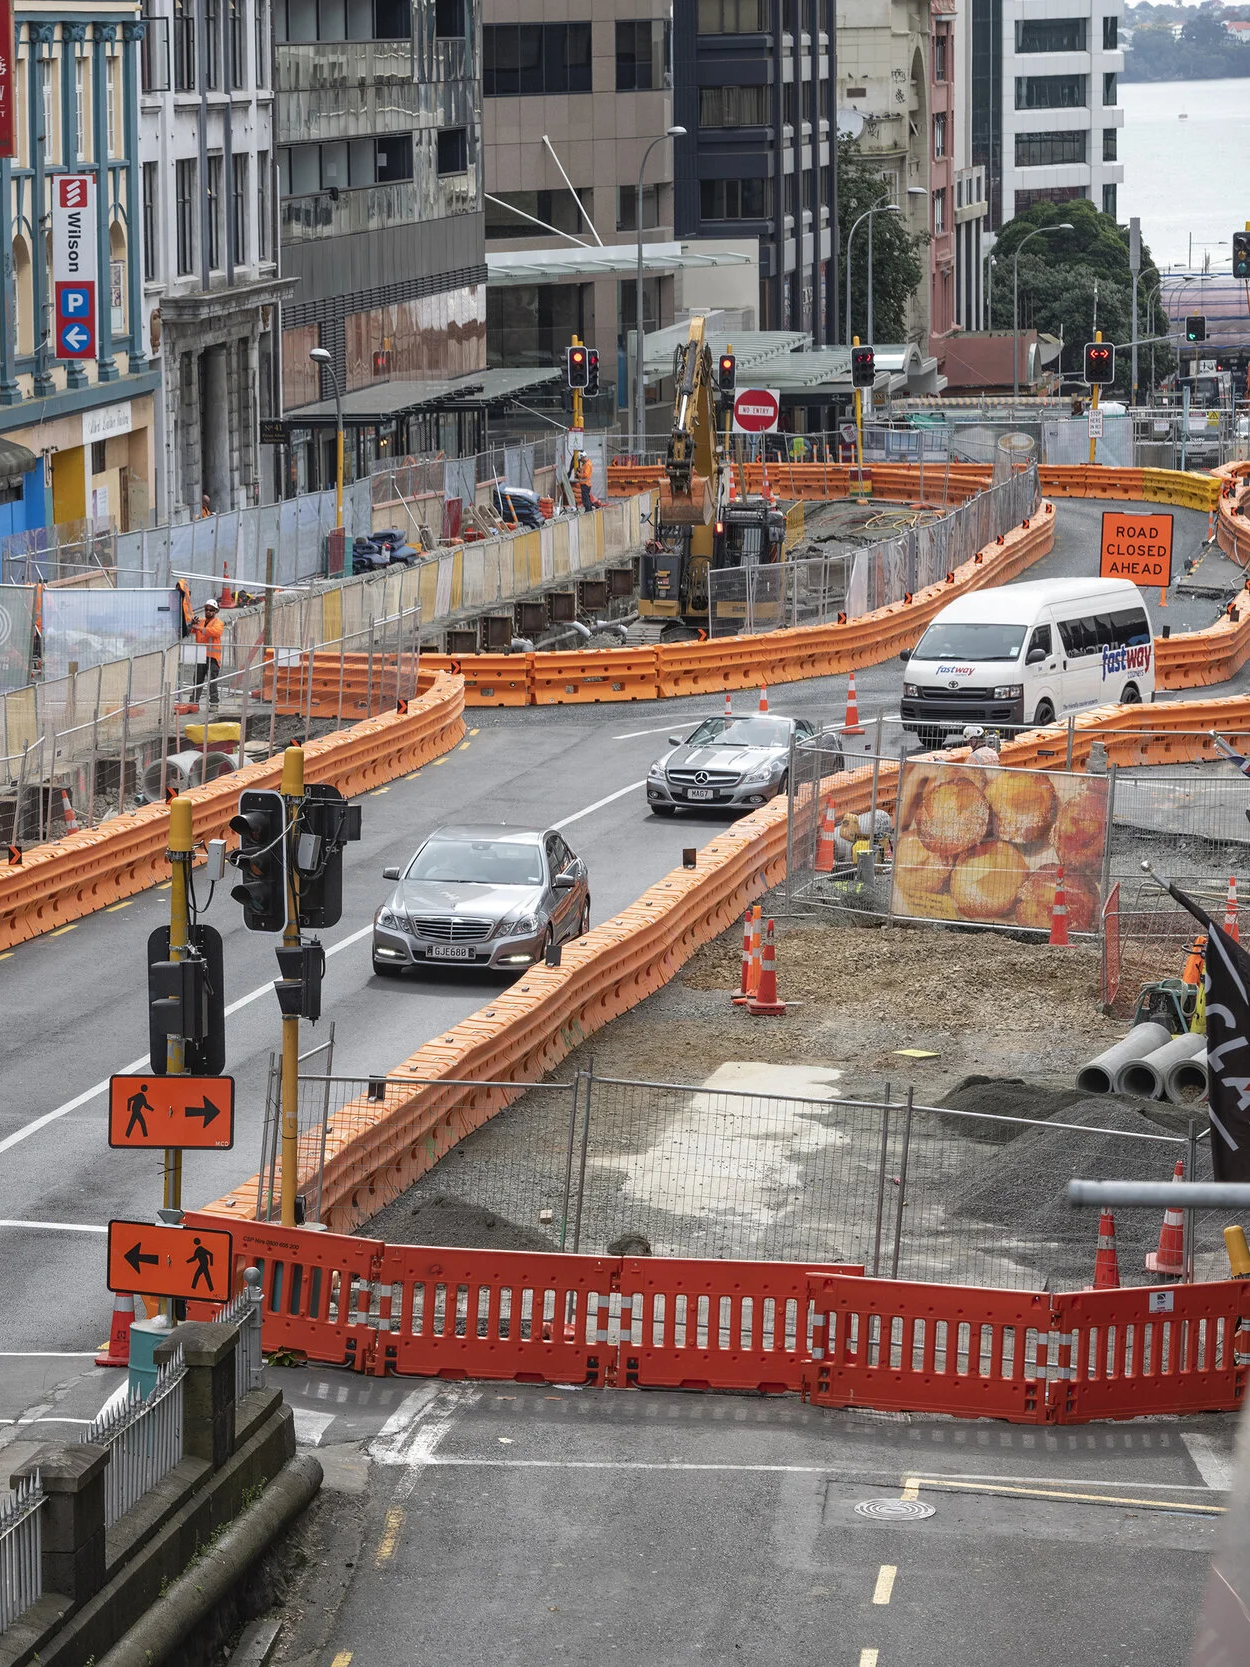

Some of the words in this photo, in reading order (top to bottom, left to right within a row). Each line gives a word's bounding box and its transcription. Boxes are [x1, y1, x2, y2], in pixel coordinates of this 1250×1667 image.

[68, 211, 81, 273] Wilson
[68, 294, 84, 312] P
[1116, 526, 1158, 539] ROAD
[1106, 544, 1166, 557] CLOSED
[1109, 562, 1162, 575] AHEAD
[1102, 643, 1152, 682] fastway
[936, 665, 976, 676] fastway
[691, 790, 708, 798] MAG7
[243, 1236, 255, 1244] CSP
[255, 1237, 266, 1245] Hire
[266, 1239, 279, 1247] 0800
